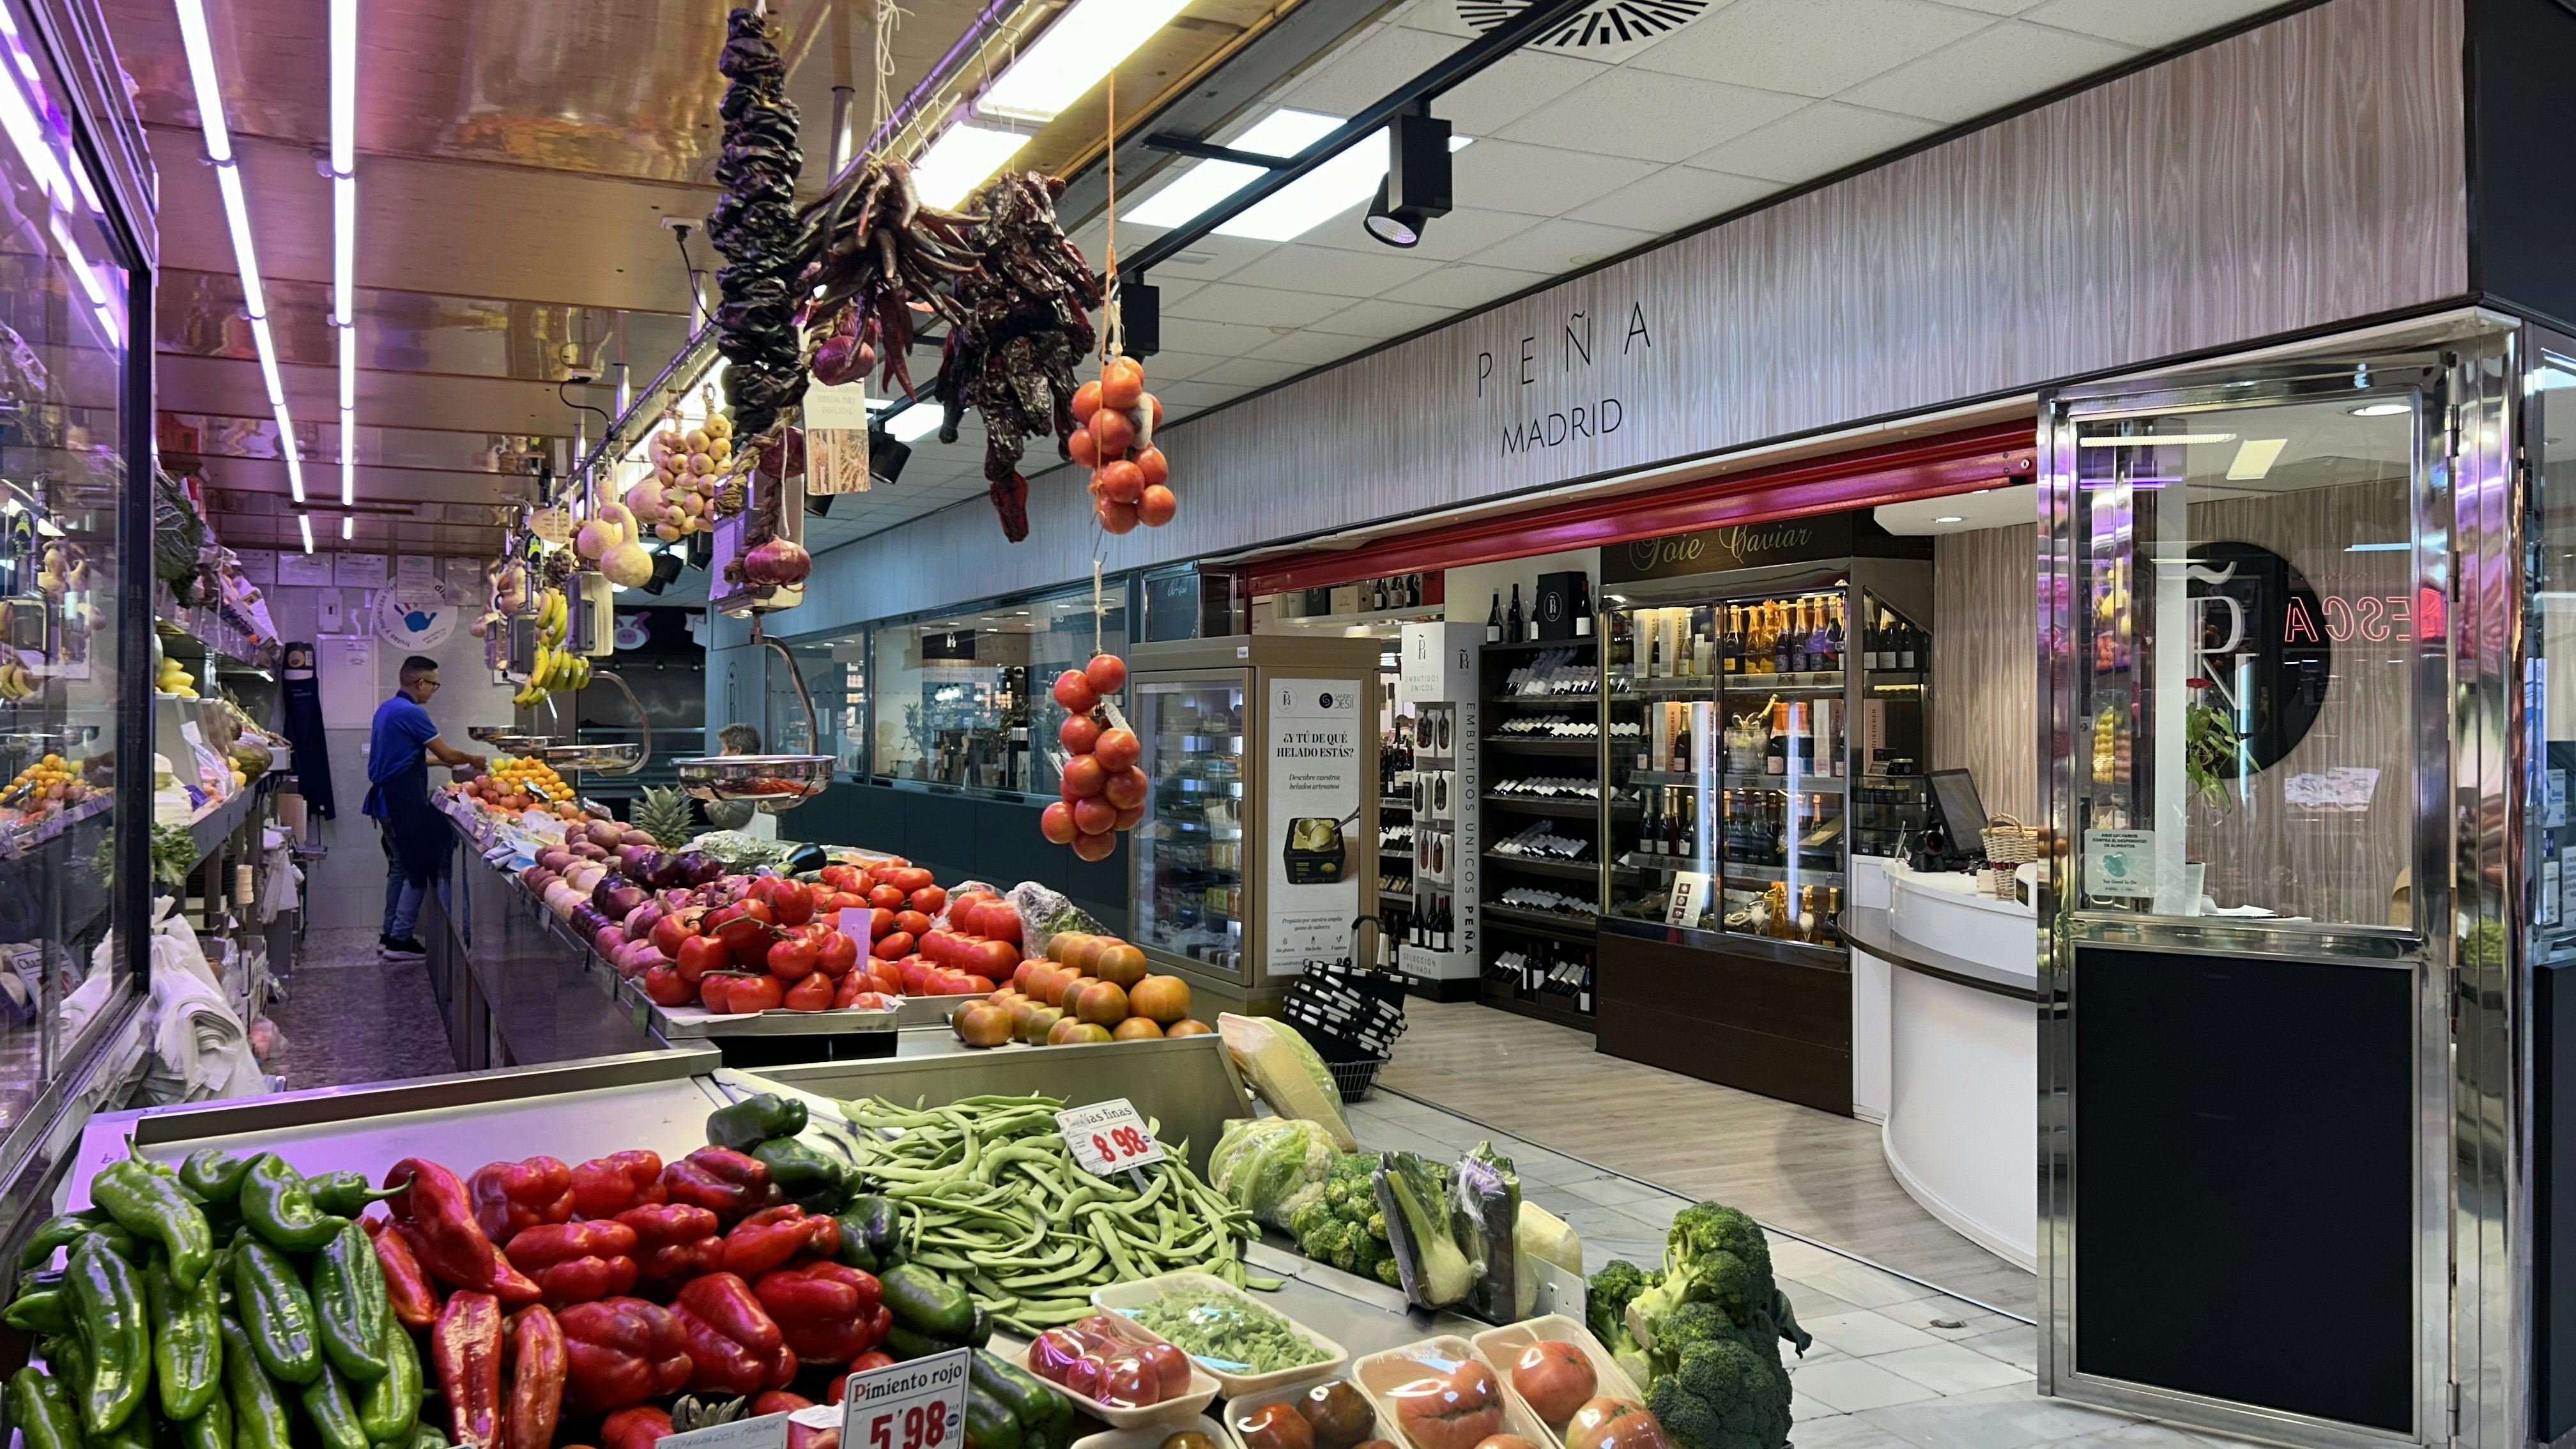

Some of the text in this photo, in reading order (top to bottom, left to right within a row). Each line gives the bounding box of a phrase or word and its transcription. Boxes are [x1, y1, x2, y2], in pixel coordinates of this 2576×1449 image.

[1478, 301, 1652, 398] PEÑA
[1501, 399, 1623, 457] MADRID
[1405, 675, 1440, 683] EMBUTIDOS
[1283, 730, 1347, 745] ¿Y TÚ DE QUÉ
[1277, 745, 1354, 758] HELADO ESTÁS?
[1464, 702, 1476, 954] EMBUTIDOS ÚNICOS PEÑA
[1402, 953, 1436, 967] SELECCIÓN
[1406, 963, 1432, 976] PRIVADA
[1102, 1107, 1133, 1120] finas
[854, 1362, 963, 1403] Pimiento rojo
[945, 1429, 959, 1441] KILO
